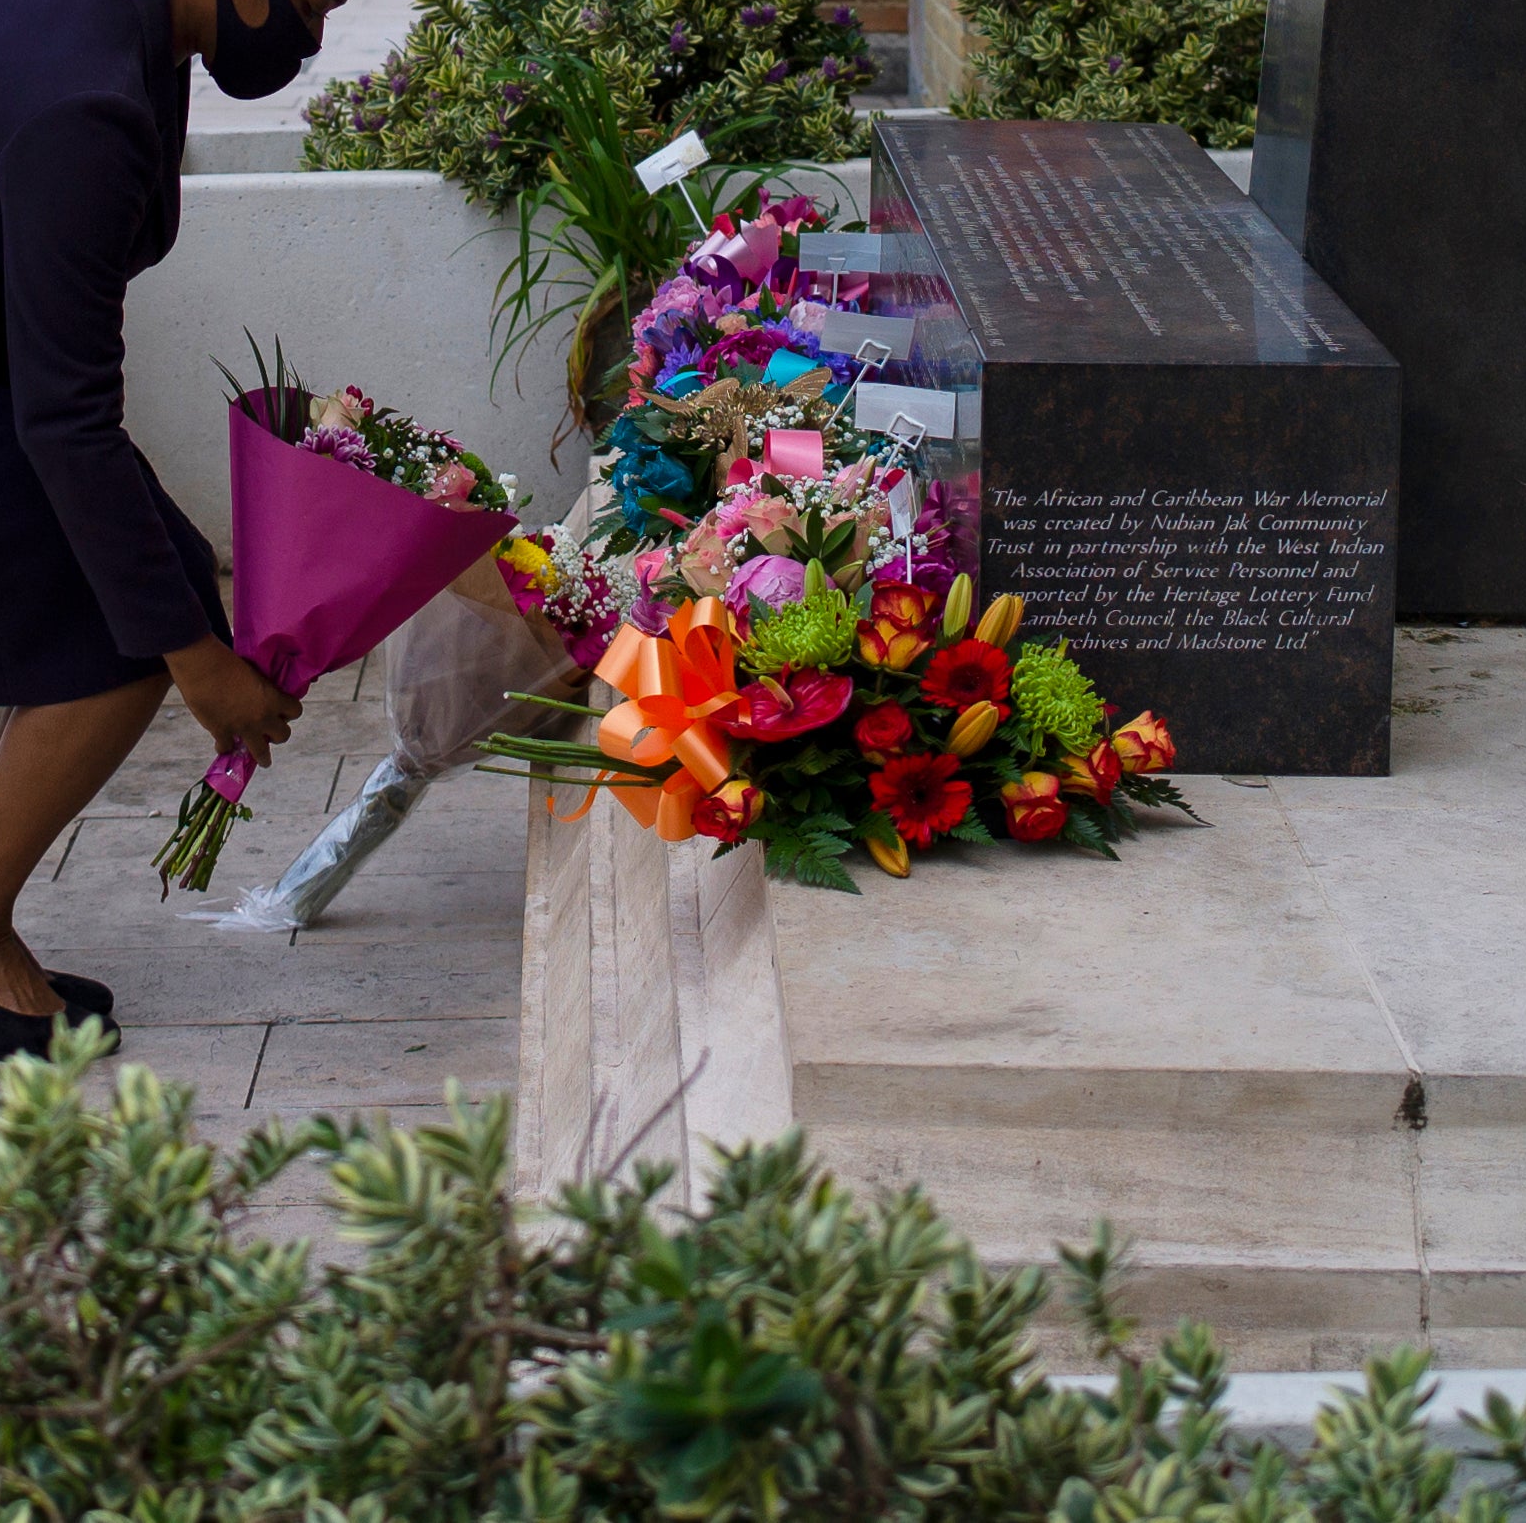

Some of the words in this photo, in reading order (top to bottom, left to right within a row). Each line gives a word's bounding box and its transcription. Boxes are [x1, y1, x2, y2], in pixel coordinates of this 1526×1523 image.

[1033, 487, 1103, 507] African
[1109, 487, 1147, 507] and
[1151, 488, 1244, 507] Caribbean
[1254, 490, 1291, 507] War
[1296, 488, 1388, 507] Memorial
[1003, 519, 1038, 531] was
[1044, 512, 1115, 531] created
[1119, 512, 1144, 536] by
[1150, 512, 1216, 531] Nubian
[1220, 512, 1250, 535] Jak
[1258, 513, 1369, 536] Community
[987, 538, 1035, 555] Trust
[1043, 543, 1062, 555] in
[1066, 536, 1178, 560] partnership
[1187, 536, 1229, 555] with
[1236, 536, 1266, 555] the
[1277, 538, 1321, 555] West
[1329, 536, 1385, 555] Indian
[1010, 561, 1116, 578] Association
[1122, 559, 1146, 578] of
[1150, 561, 1220, 579] Service
[1228, 560, 1320, 579] Personnel
[1322, 560, 1360, 578] and
[1094, 583, 1119, 607] by
[1126, 583, 1155, 603] the
[1163, 585, 1241, 608] Heritage
[1248, 585, 1319, 608] Lottery
[1105, 607, 1176, 628] Council,
[1184, 608, 1214, 626] the
[1222, 607, 1268, 626] Black
[1278, 607, 1355, 626] Cultural
[1135, 631, 1173, 650] and
[1176, 631, 1267, 650] Madstone
